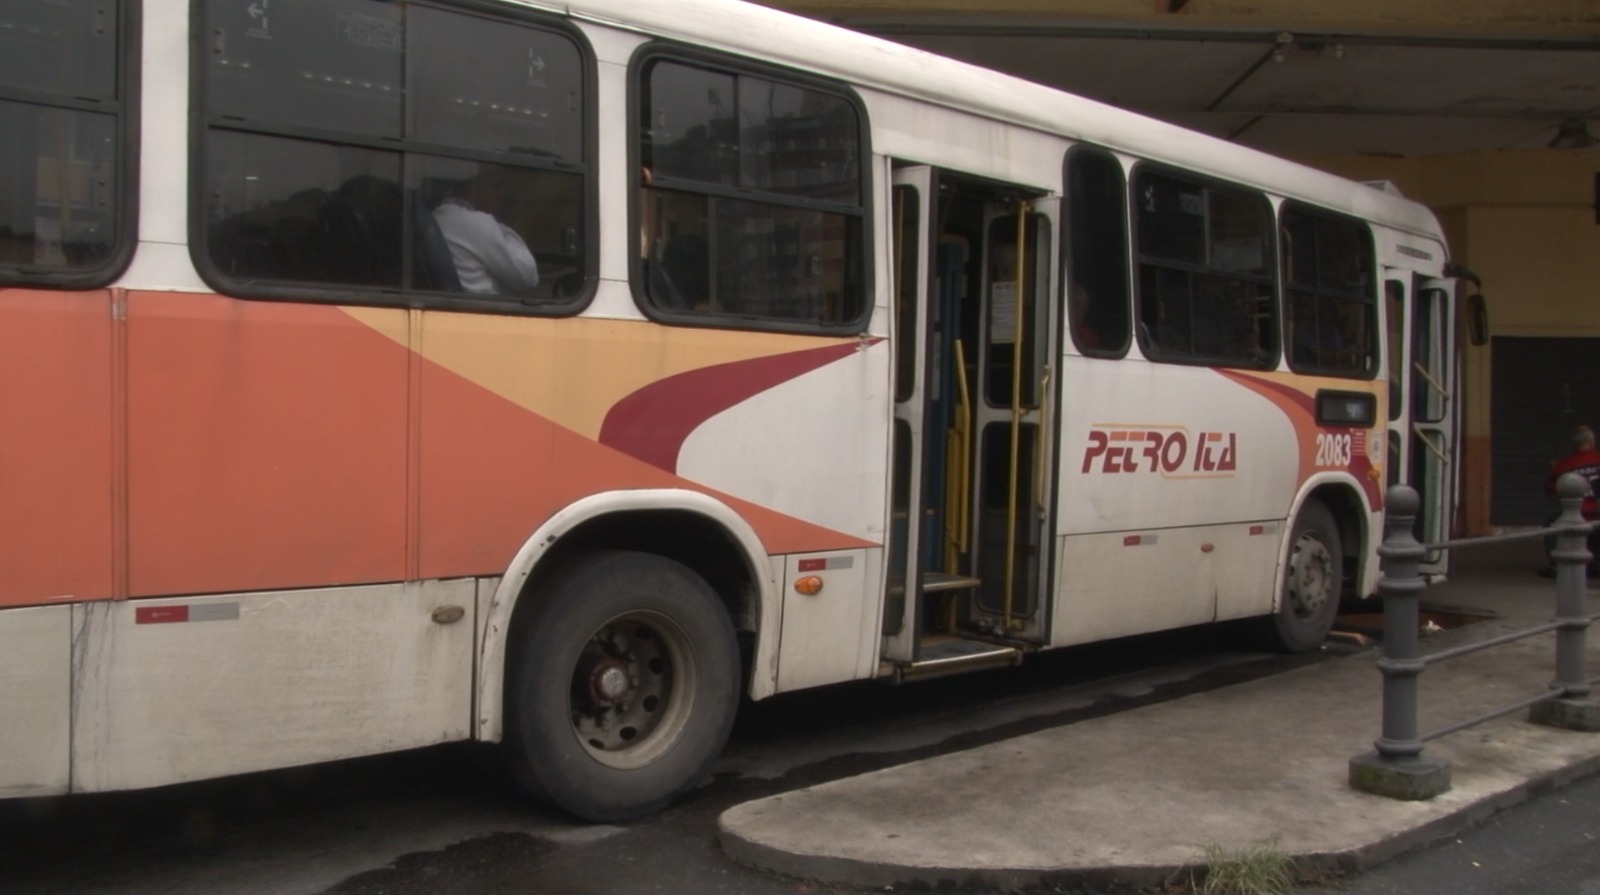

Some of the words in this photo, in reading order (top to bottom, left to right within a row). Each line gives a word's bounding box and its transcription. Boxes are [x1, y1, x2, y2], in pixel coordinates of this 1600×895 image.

[1081, 430, 1188, 474] PETRO
[1193, 431, 1237, 472] ITA
[1315, 433, 1351, 467] 2083
